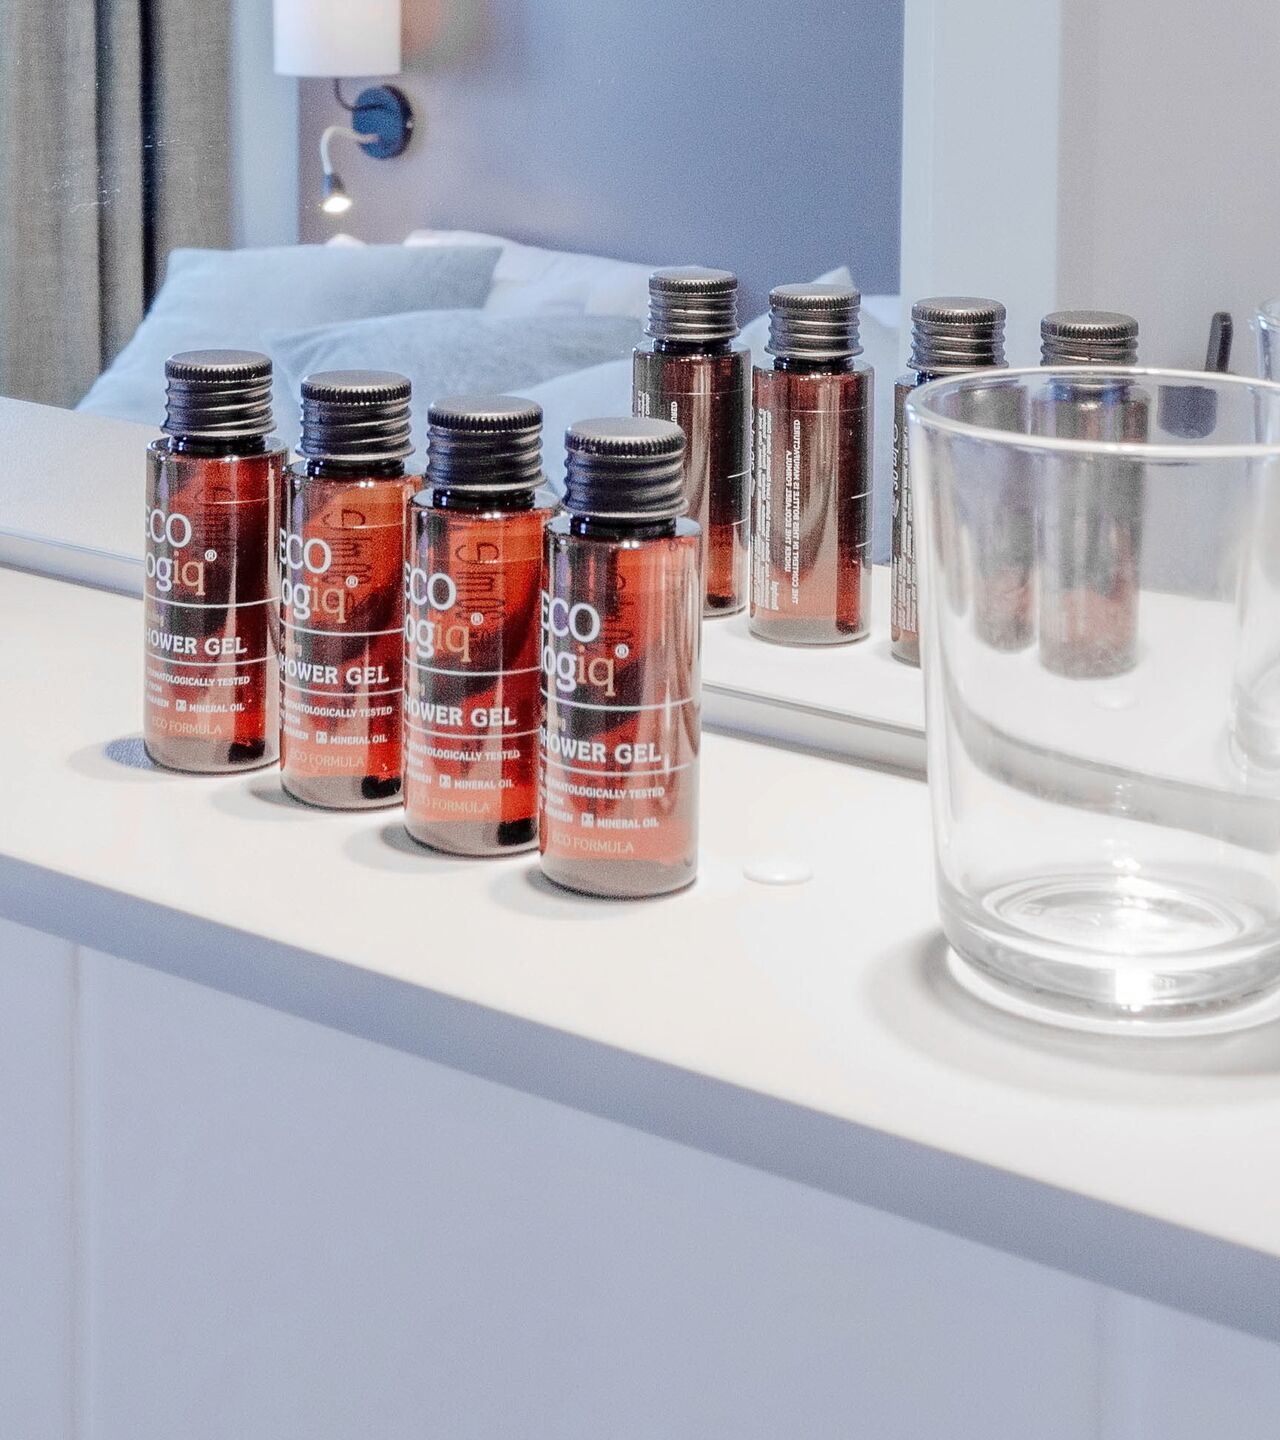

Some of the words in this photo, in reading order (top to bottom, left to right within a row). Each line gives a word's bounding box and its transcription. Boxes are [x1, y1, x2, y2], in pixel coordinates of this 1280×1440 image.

[280, 528, 332, 574] ECO
[404, 563, 457, 610] ECO
[541, 590, 600, 643] ECO
[145, 628, 198, 655] HOWER
[204, 637, 248, 656] GEL
[146, 666, 216, 687] MATOLOGICALLY
[218, 675, 251, 687] TESTED
[346, 666, 390, 686] GEL
[189, 703, 228, 714] MINERAL
[230, 702, 245, 712] OIL
[284, 698, 358, 718] MATOLOGICALLY
[360, 706, 393, 718] TESTED
[404, 694, 463, 727] HOWER
[471, 708, 518, 728] GEL
[168, 720, 223, 734] FORMULA
[330, 736, 370, 746] MINERAL
[372, 734, 388, 744] OIL
[309, 753, 366, 768] FORMULA
[408, 741, 482, 762] MATOLOGICALLY
[486, 749, 521, 762] TESTED
[615, 742, 662, 765] GEL
[454, 778, 497, 790] MINERAL
[498, 778, 514, 789] OIL
[546, 775, 628, 800] MATOLOGICALLY
[630, 787, 666, 800] TESTED
[432, 797, 491, 814] FORMULA
[597, 818, 641, 830] MINERAL
[642, 818, 660, 829] OIL
[573, 836, 634, 854] FORMULA
